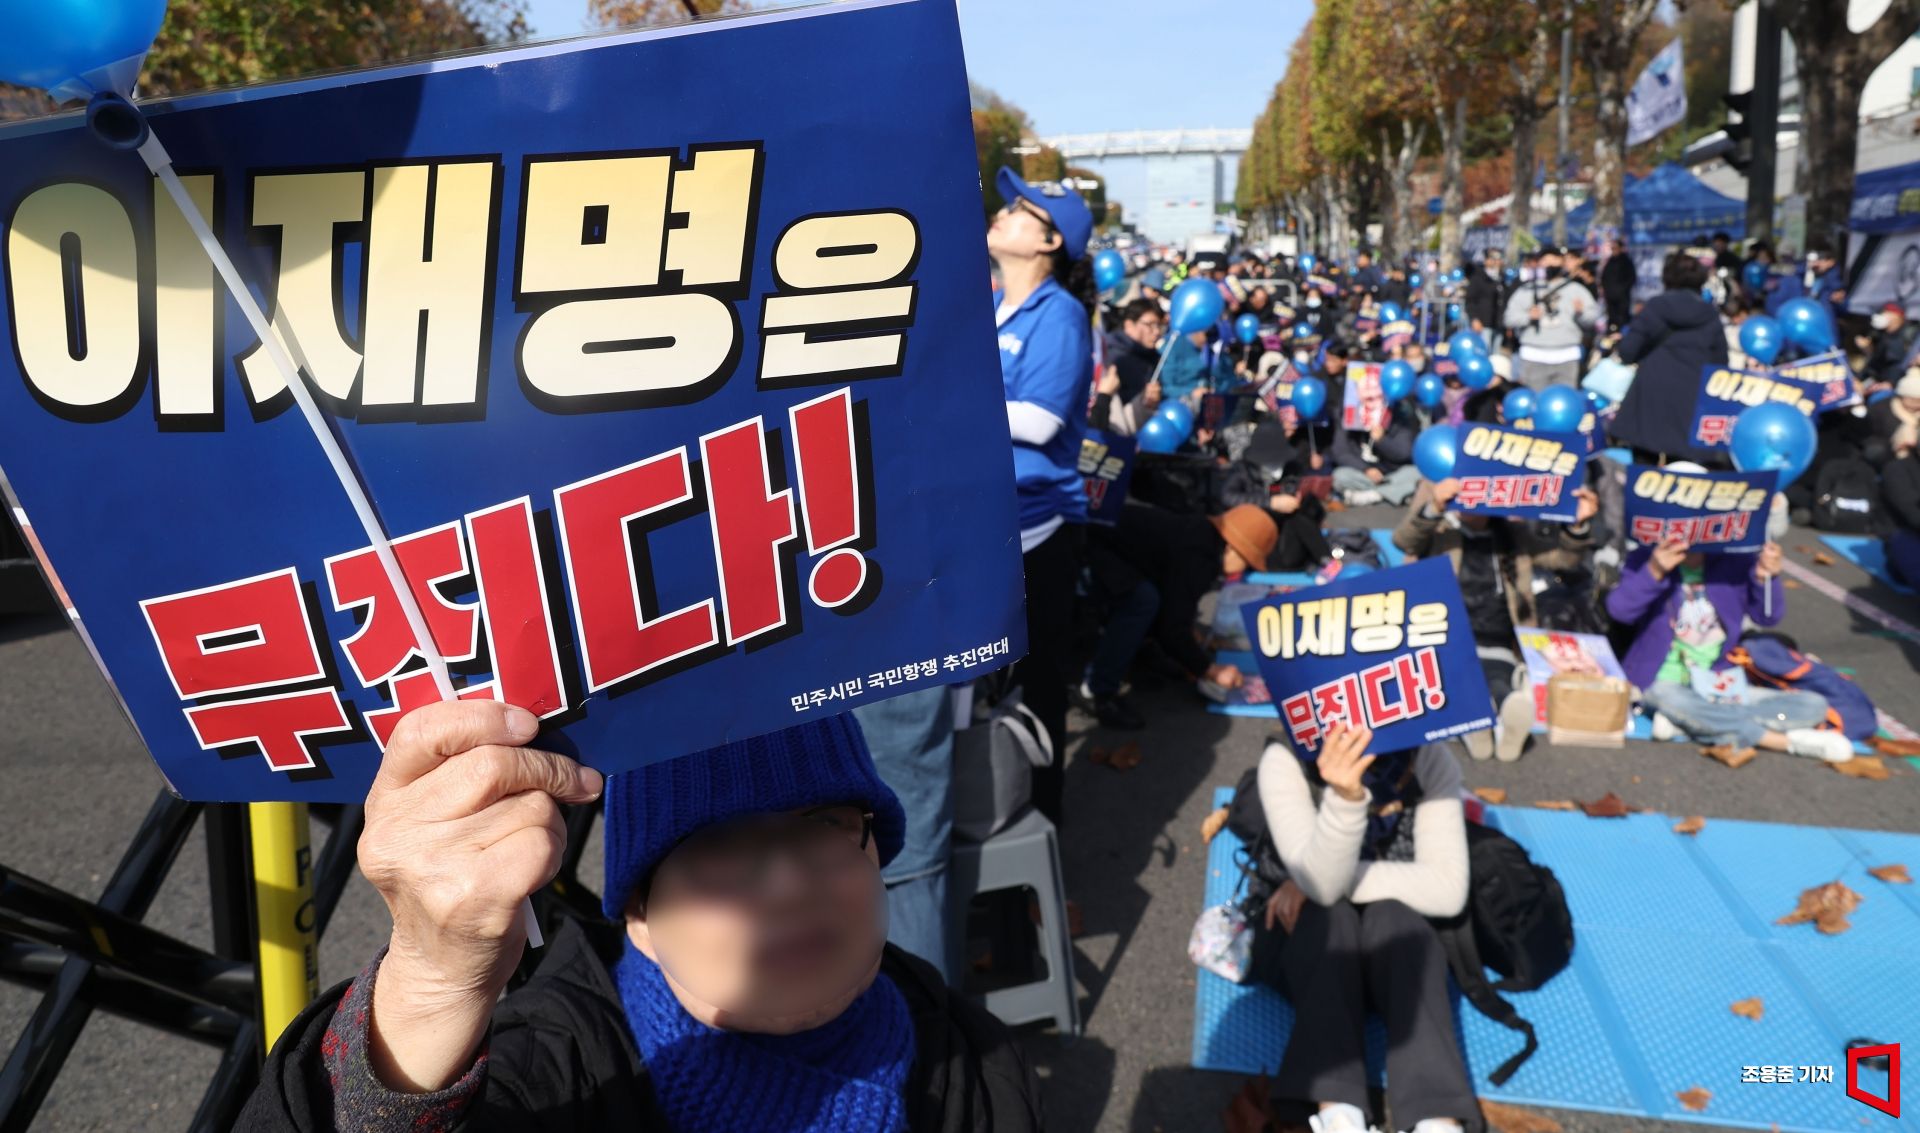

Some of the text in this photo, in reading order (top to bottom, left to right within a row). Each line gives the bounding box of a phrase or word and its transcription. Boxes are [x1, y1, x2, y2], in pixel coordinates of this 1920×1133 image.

[6, 147, 920, 416] 이재명은
[1463, 427, 1579, 476] 이재명은
[1455, 474, 1564, 509] 무죄다!
[1633, 470, 1767, 511] 이재명은
[1631, 511, 1752, 546] 무죄다!
[138, 387, 868, 772] 무죄다!
[1257, 589, 1448, 659] 이재명은
[791, 636, 1010, 713] 민주시민 국민항쟁 추진연대
[1282, 645, 1446, 752] 무죄다!
